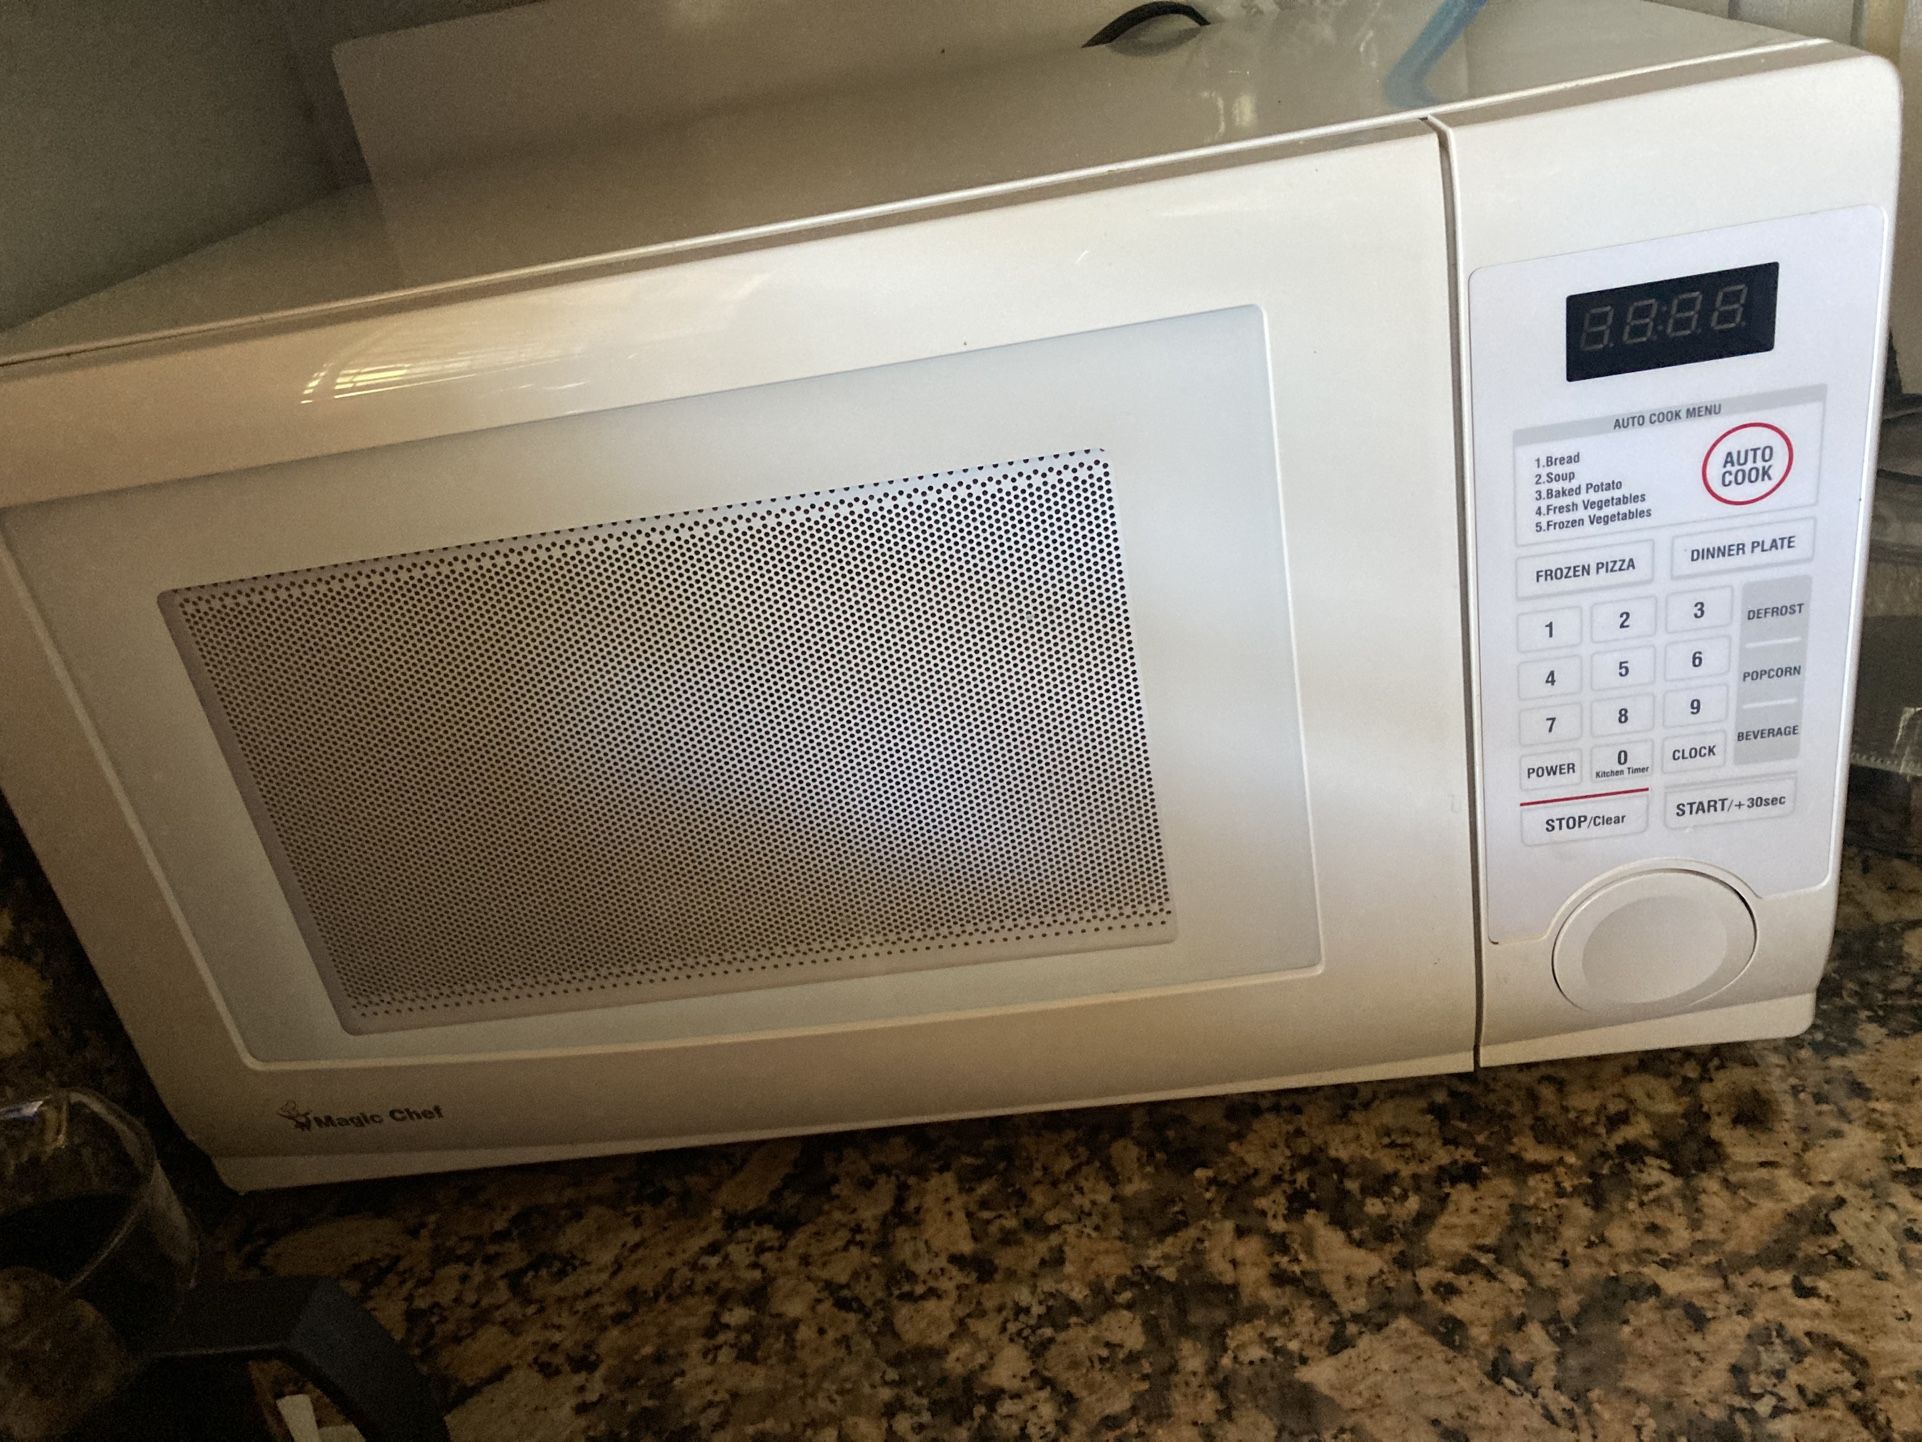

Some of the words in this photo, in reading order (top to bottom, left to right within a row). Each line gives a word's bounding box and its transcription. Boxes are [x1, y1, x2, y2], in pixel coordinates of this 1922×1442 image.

[1613, 415, 1645, 430] AUTO
[1649, 409, 1682, 425] COOK
[1685, 403, 1722, 419] MENU
[1535, 452, 1580, 469] 1.Bread
[1723, 445, 1774, 468] AUTO
[1535, 471, 1576, 485] 2.Soup
[1720, 465, 1773, 488] COOK
[1535, 485, 1582, 501] 3.Baked
[1585, 479, 1623, 494] Potato
[1535, 500, 1579, 517] 4.Fresh
[1582, 492, 1646, 512] Vegetables
[1535, 516, 1585, 533] 5.Frozen
[1587, 508, 1652, 527] Vegetables
[1690, 544, 1746, 562] DINNER
[1750, 535, 1796, 554] PLATE
[1535, 565, 1591, 583] FROZEN
[1596, 558, 1636, 575] PIZZA
[1693, 602, 1705, 619] 3
[1747, 603, 1805, 621] DEFROST
[1618, 612, 1631, 629] 2
[1545, 622, 1554, 638] 1
[1691, 651, 1703, 668] 6
[1618, 660, 1629, 678] 5
[1742, 665, 1802, 683] POPCORN
[1545, 670, 1556, 687] 4
[1689, 699, 1701, 715] 9
[1618, 708, 1629, 724] 8
[1545, 717, 1556, 734] 7
[1737, 725, 1799, 742] BEVERAGE
[1617, 750, 1628, 765] 0
[1672, 744, 1717, 762] CLOCK
[1526, 762, 1576, 779] POWER
[1595, 769, 1624, 778] Kitchen
[1626, 766, 1649, 775] Timer
[1545, 813, 1626, 833] STOP/Clear
[313, 1111, 384, 1128] Magic
[389, 1105, 444, 1122] Chef
